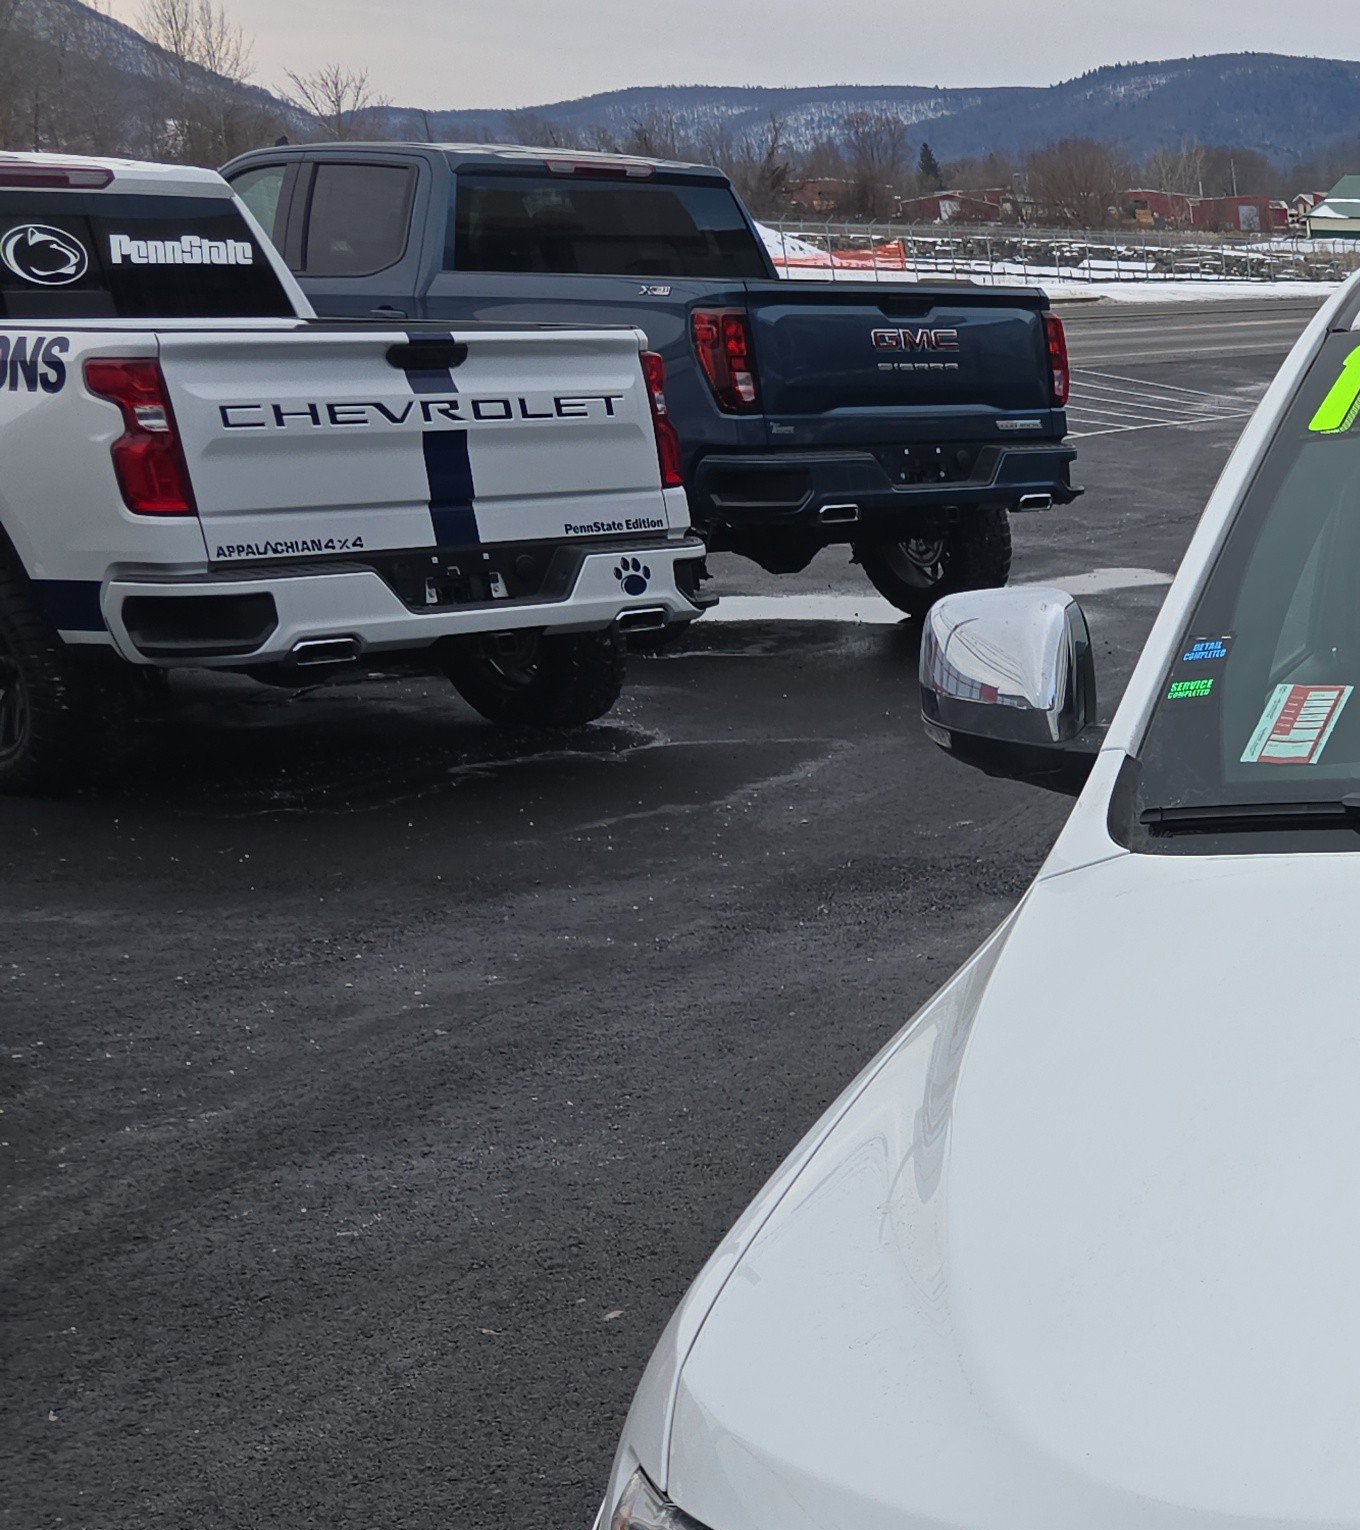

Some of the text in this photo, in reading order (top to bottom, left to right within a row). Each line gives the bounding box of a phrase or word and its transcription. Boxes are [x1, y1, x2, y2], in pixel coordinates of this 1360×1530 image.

[109, 234, 254, 265] PennState
[870, 328, 961, 353] GMC
[218, 394, 625, 429] CHEVROLET
[564, 518, 664, 535] PennState Edition
[216, 540, 323, 559] APPALACHIAN
[1167, 688, 1211, 700] COMPLETED
[1170, 678, 1214, 692] SERVICE
